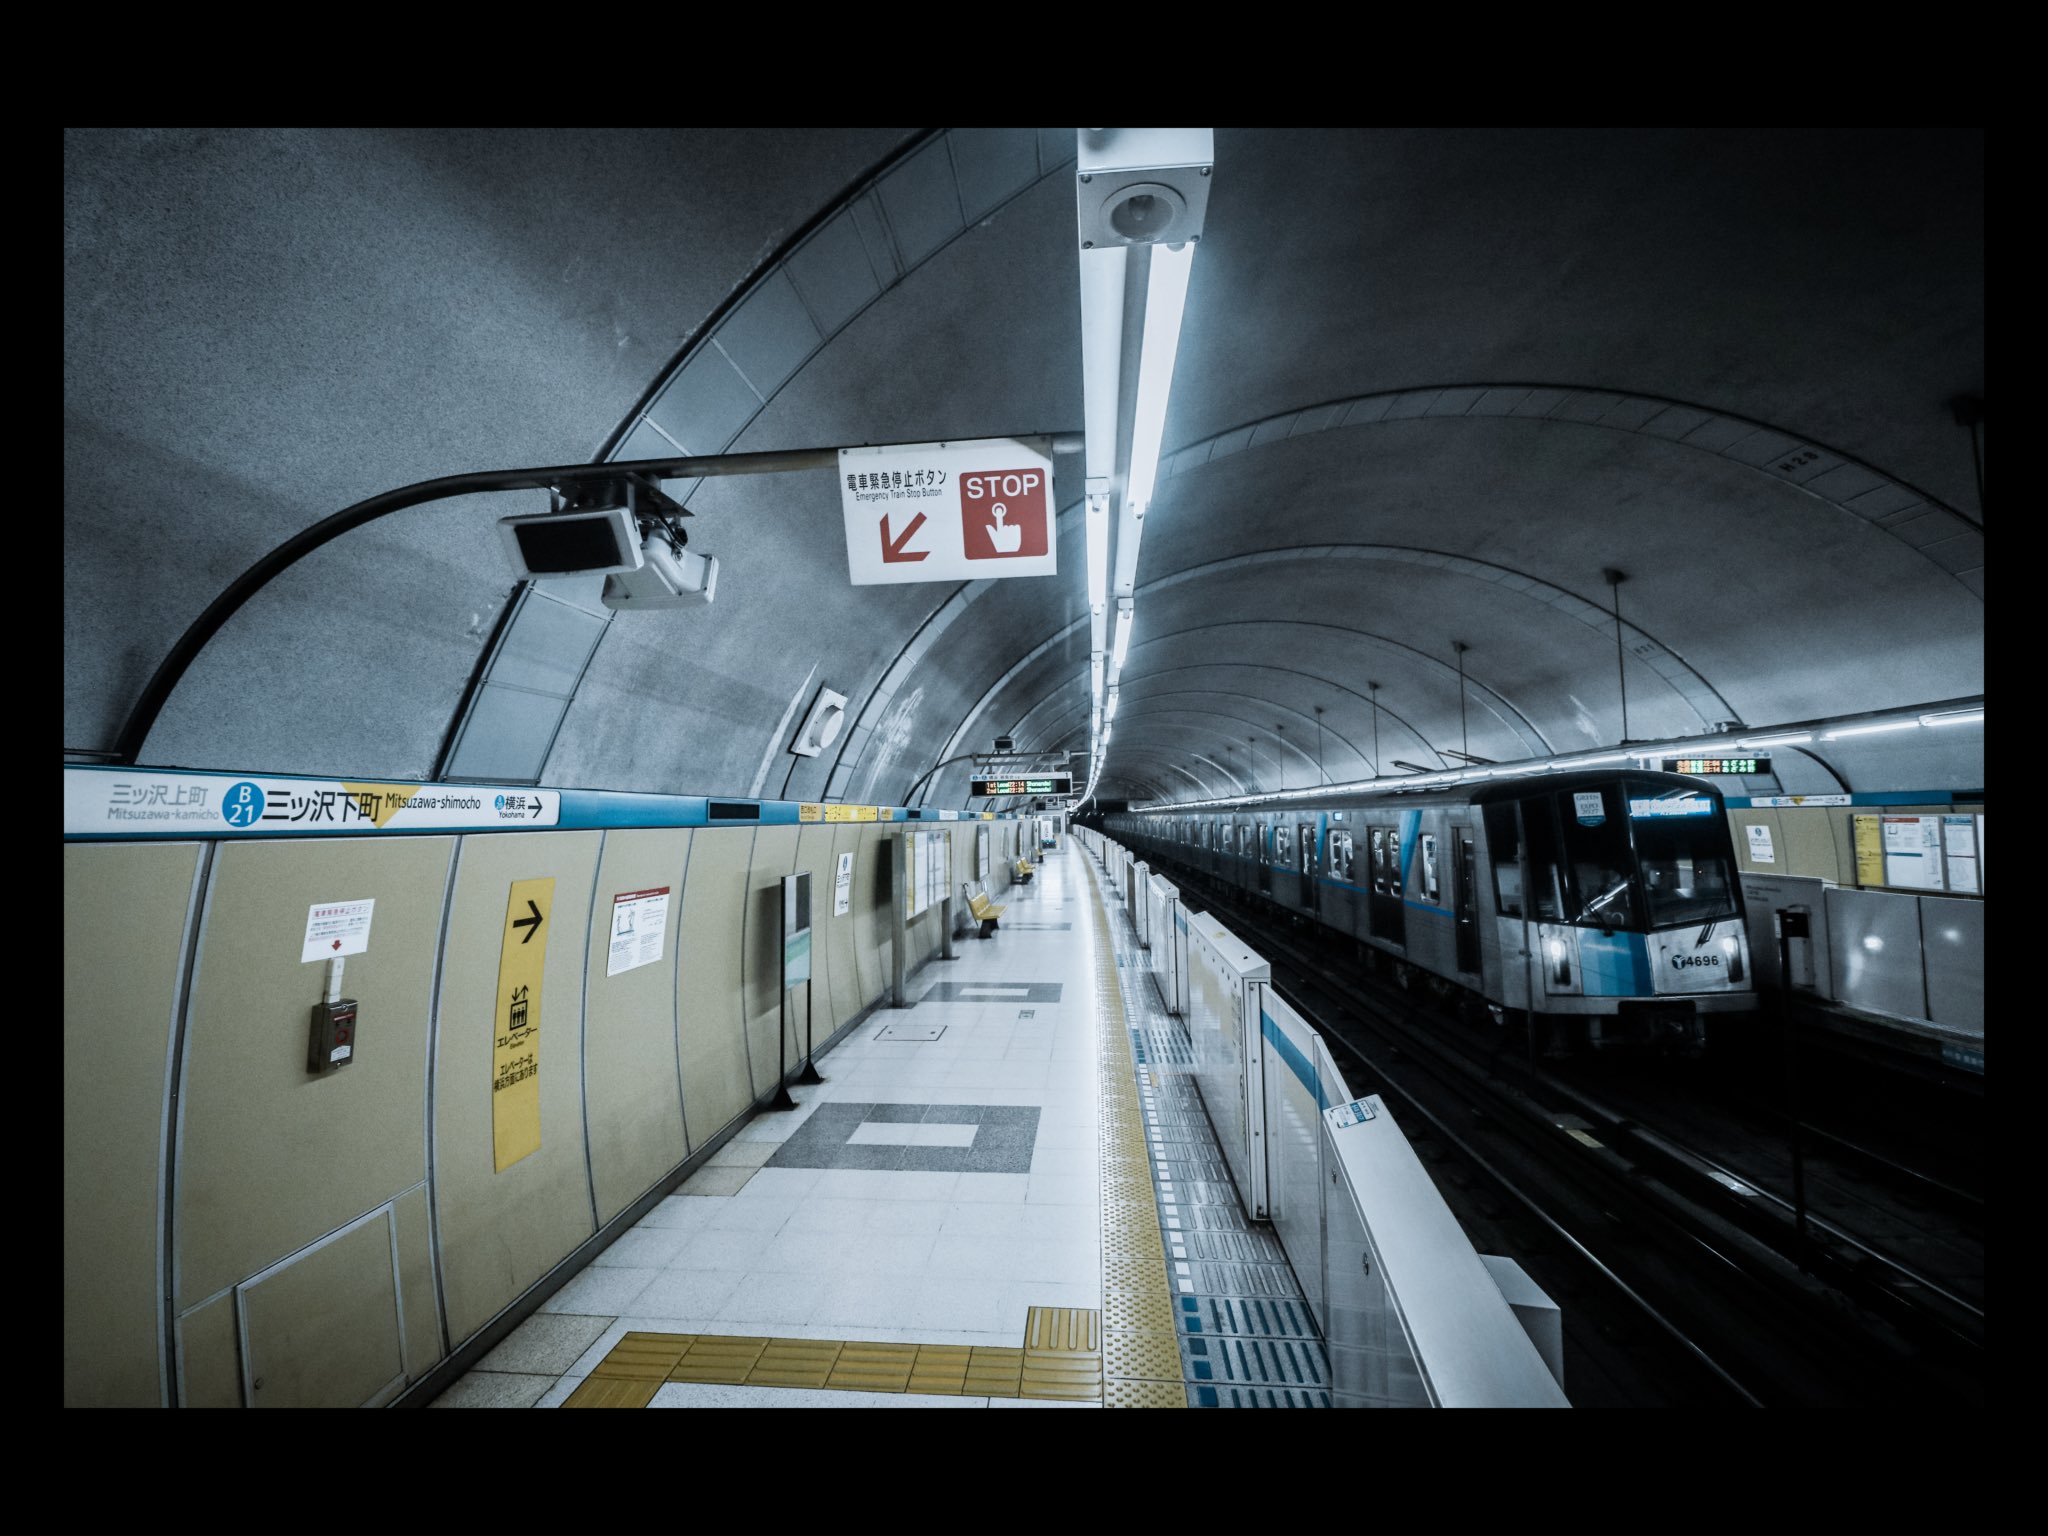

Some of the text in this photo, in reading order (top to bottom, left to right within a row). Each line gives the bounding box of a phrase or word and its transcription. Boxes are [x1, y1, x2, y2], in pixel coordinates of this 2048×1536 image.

[846, 469, 947, 492] 電車緊急停止ボタン
[966, 473, 1040, 499] STOP
[855, 487, 943, 502] Emergency Train Stop Button
[109, 783, 209, 807] 三ツ沢上町
[239, 785, 252, 803] B
[384, 792, 481, 811] Mitsuzawa-shimocho
[505, 796, 526, 810] 横浜
[107, 806, 220, 821] Mitsuzawa-kamicho
[228, 804, 254, 823] 21
[261, 789, 383, 823] 三ツ沢下町
[498, 811, 525, 819] Yokohama
[1686, 955, 1719, 967] 4696
[496, 1027, 538, 1048] エレベーター
